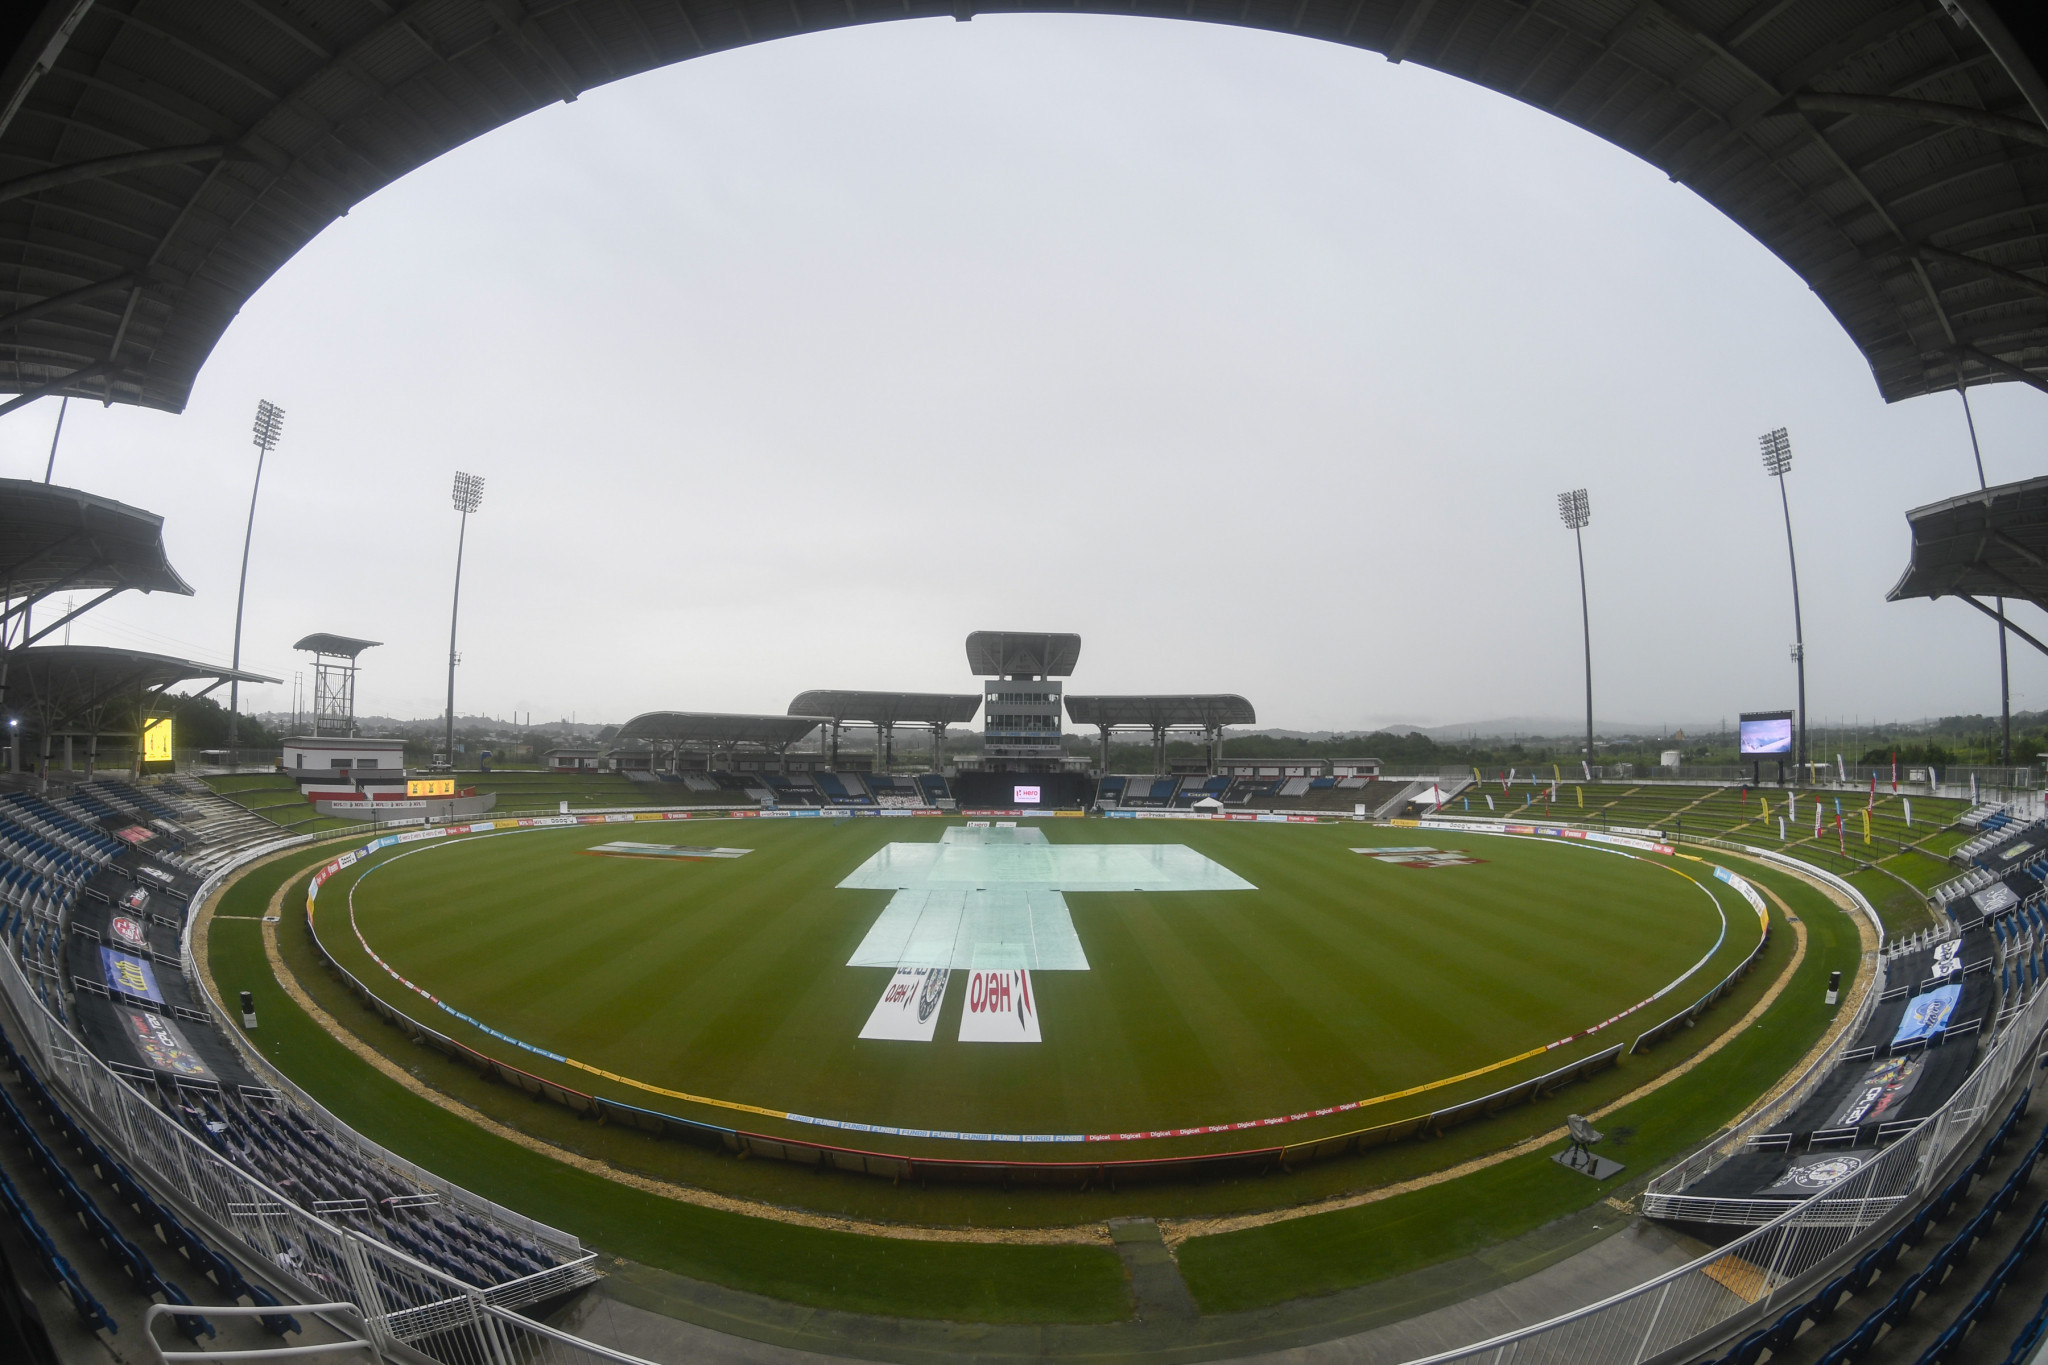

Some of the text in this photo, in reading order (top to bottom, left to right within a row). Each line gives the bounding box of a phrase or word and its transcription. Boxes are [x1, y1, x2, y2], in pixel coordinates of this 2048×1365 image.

[885, 984, 908, 1003] Hero
[970, 972, 1012, 1013] Hero
[1339, 1102, 1357, 1111] Digicel
[1290, 1112, 1309, 1120] Digicel
[1315, 1108, 1334, 1116] Digicel
[1237, 1121, 1256, 1129] Digicel
